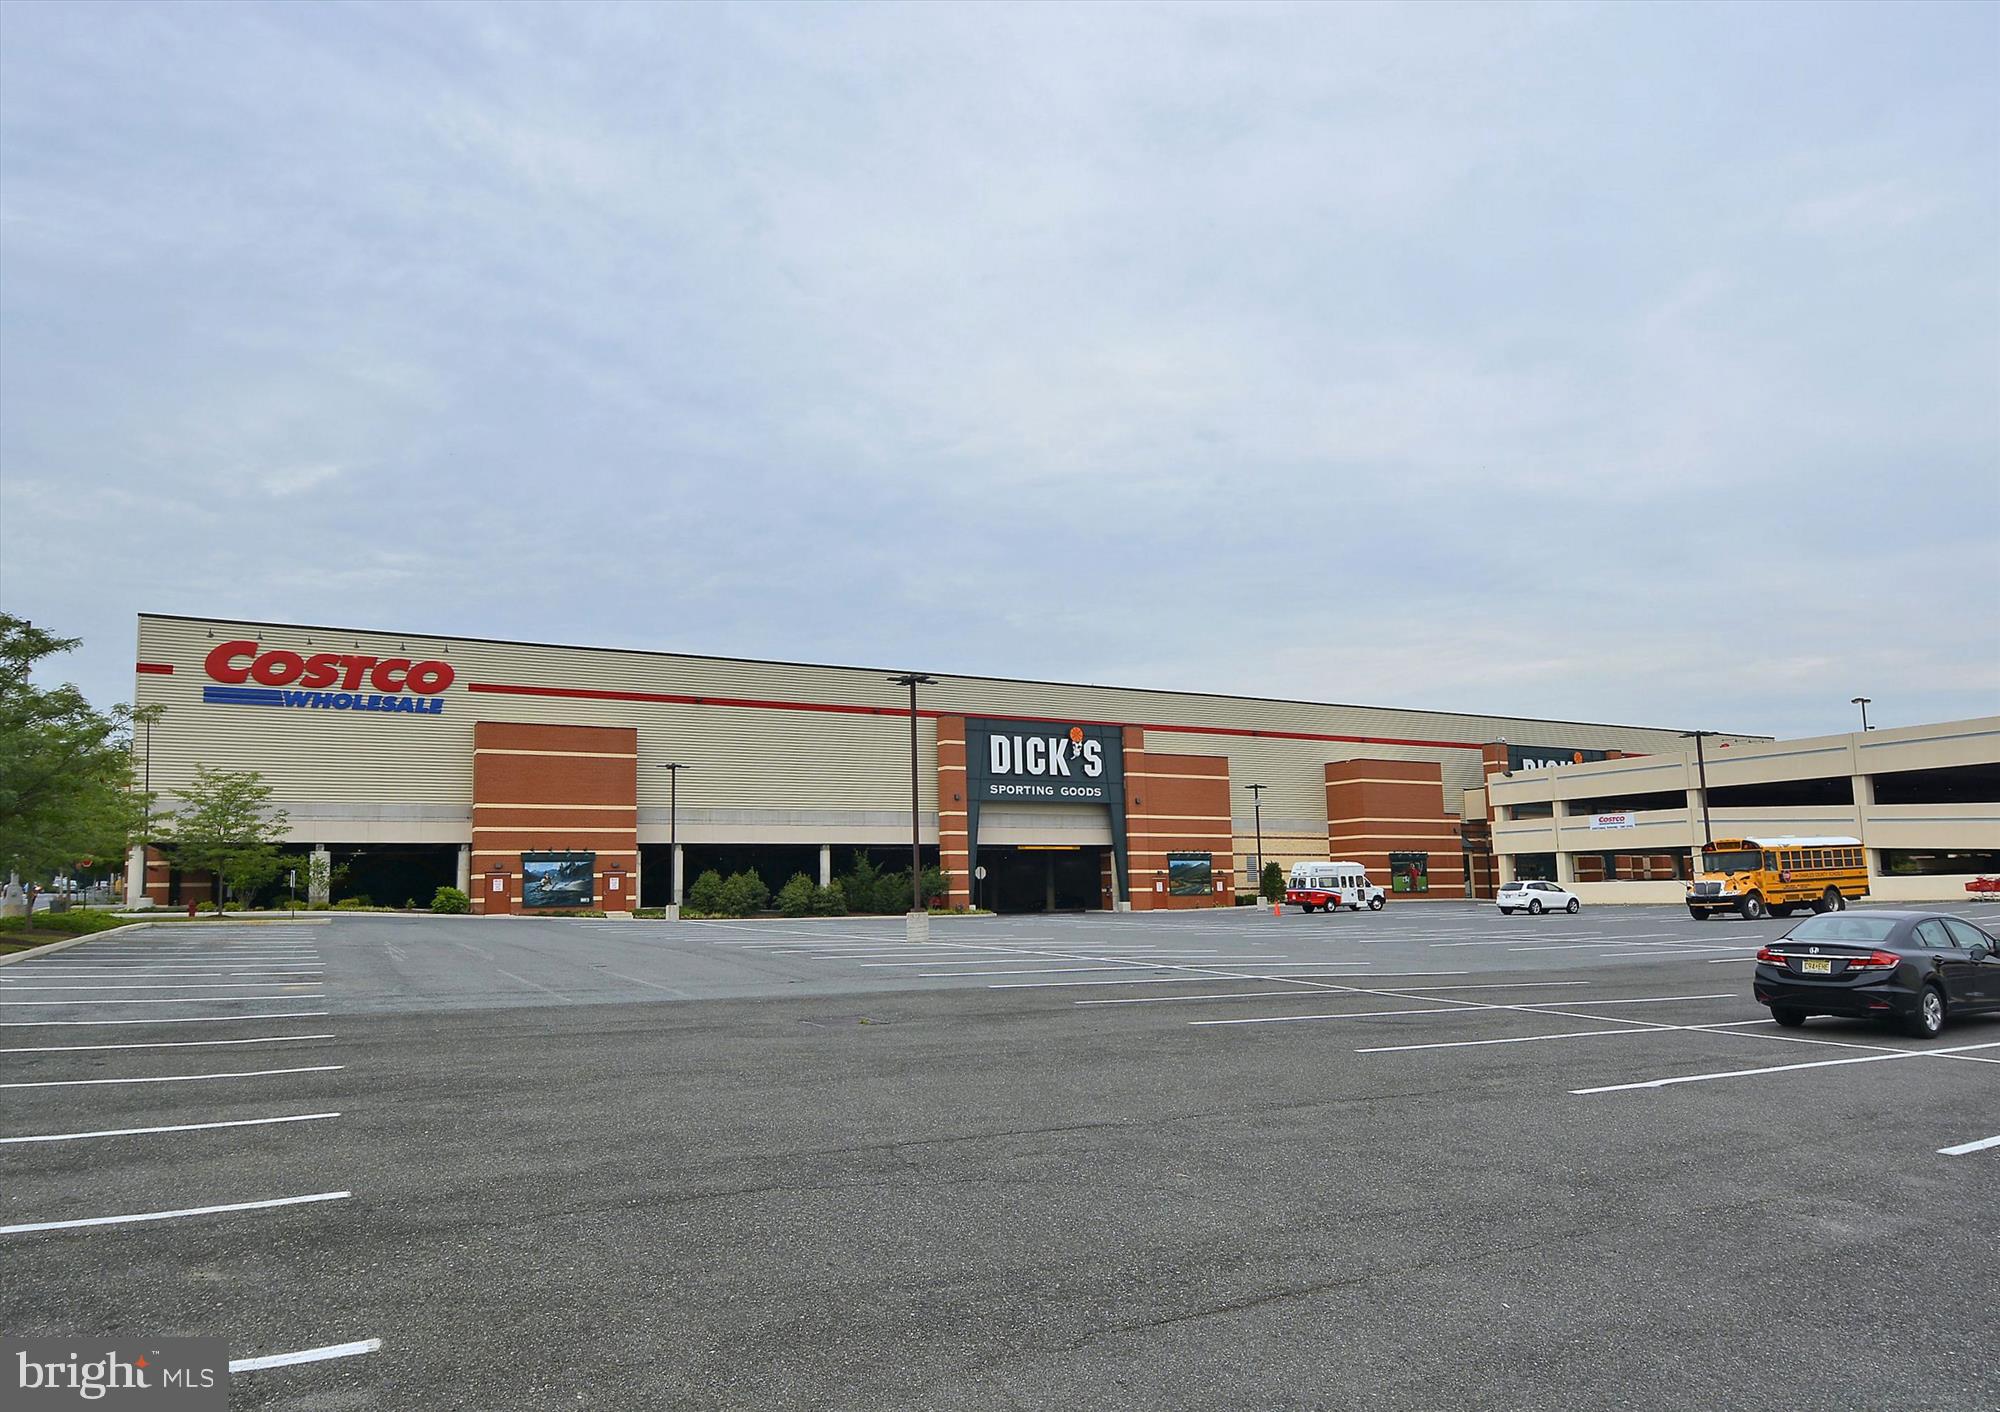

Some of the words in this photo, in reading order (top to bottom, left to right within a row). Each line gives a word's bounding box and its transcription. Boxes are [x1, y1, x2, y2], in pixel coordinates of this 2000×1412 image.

[204, 640, 455, 695] COSTCO
[281, 691, 445, 714] WHOLESALE
[990, 727, 1103, 777] DICK'S
[990, 784, 1054, 796] SPORTING
[1060, 786, 1102, 797] GOODS
